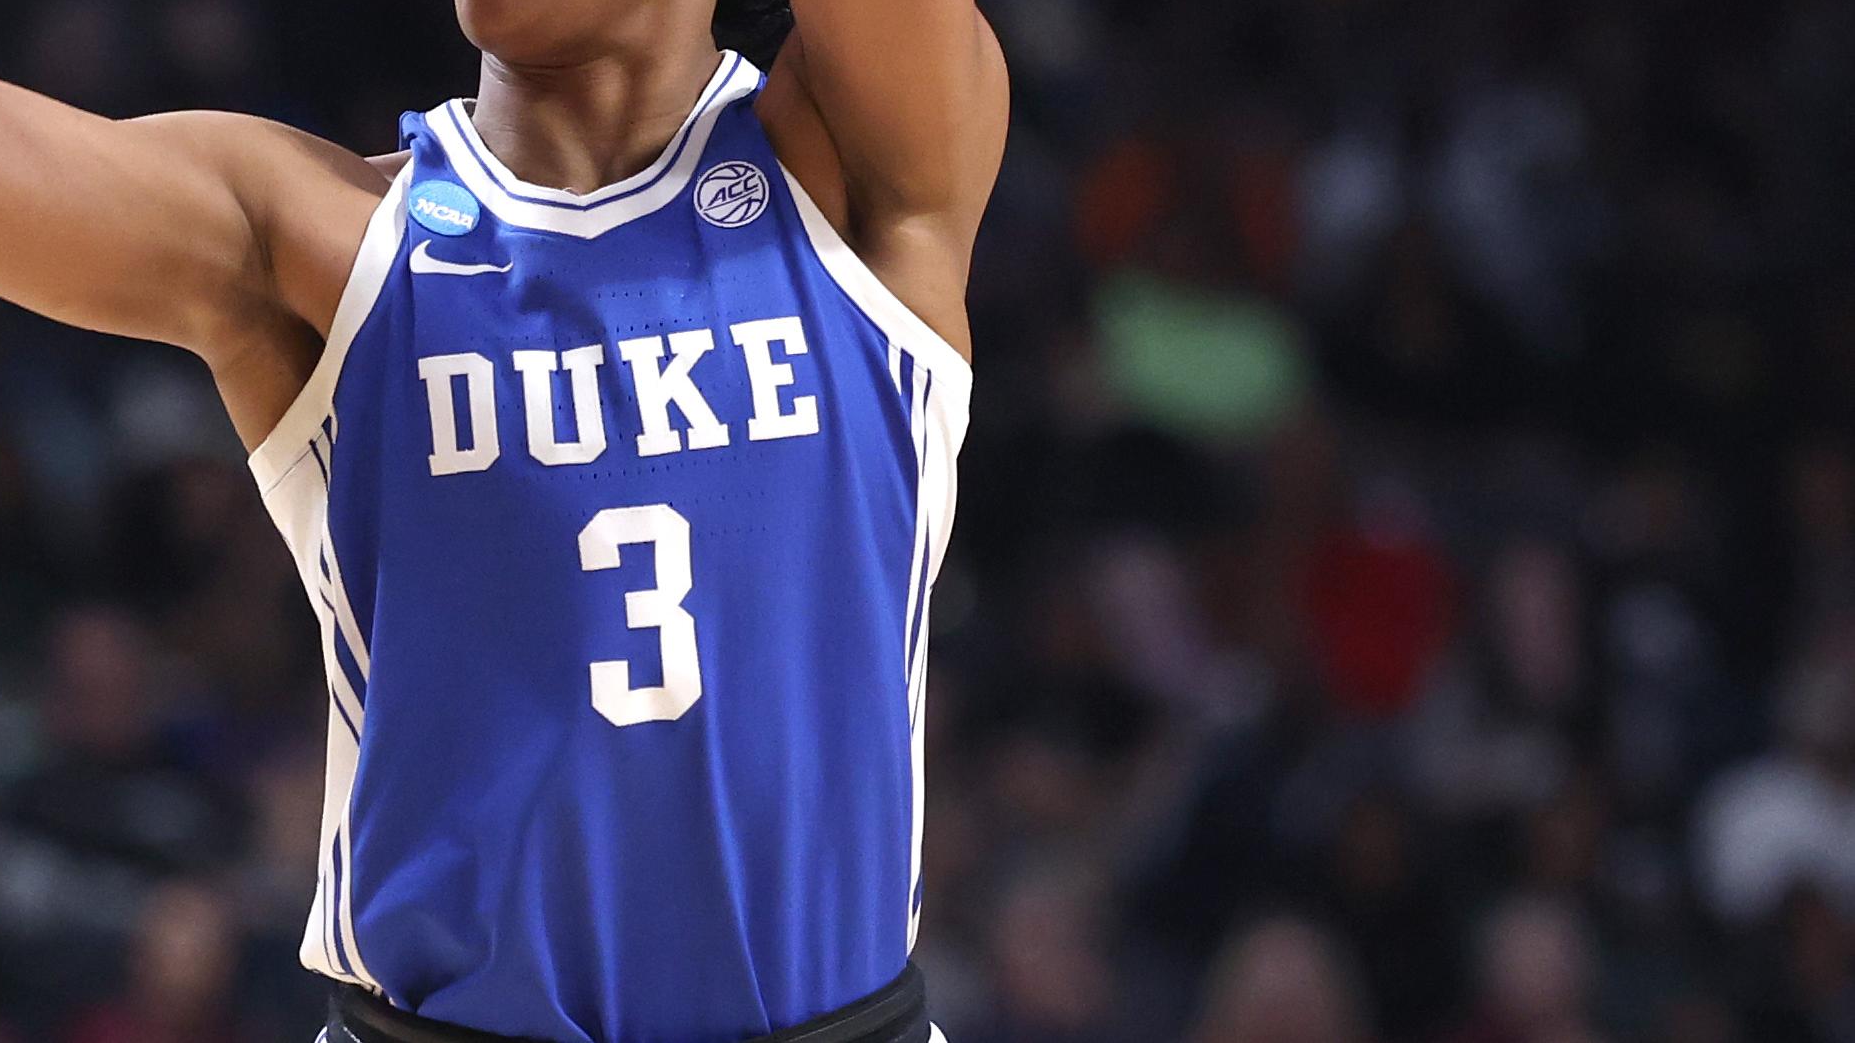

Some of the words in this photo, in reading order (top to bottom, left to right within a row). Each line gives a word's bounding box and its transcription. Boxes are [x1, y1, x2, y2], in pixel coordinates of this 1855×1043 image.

[414, 196, 475, 231] NCAA
[707, 173, 759, 207] ACC
[417, 316, 820, 476] DUKE
[577, 503, 703, 727] 3
